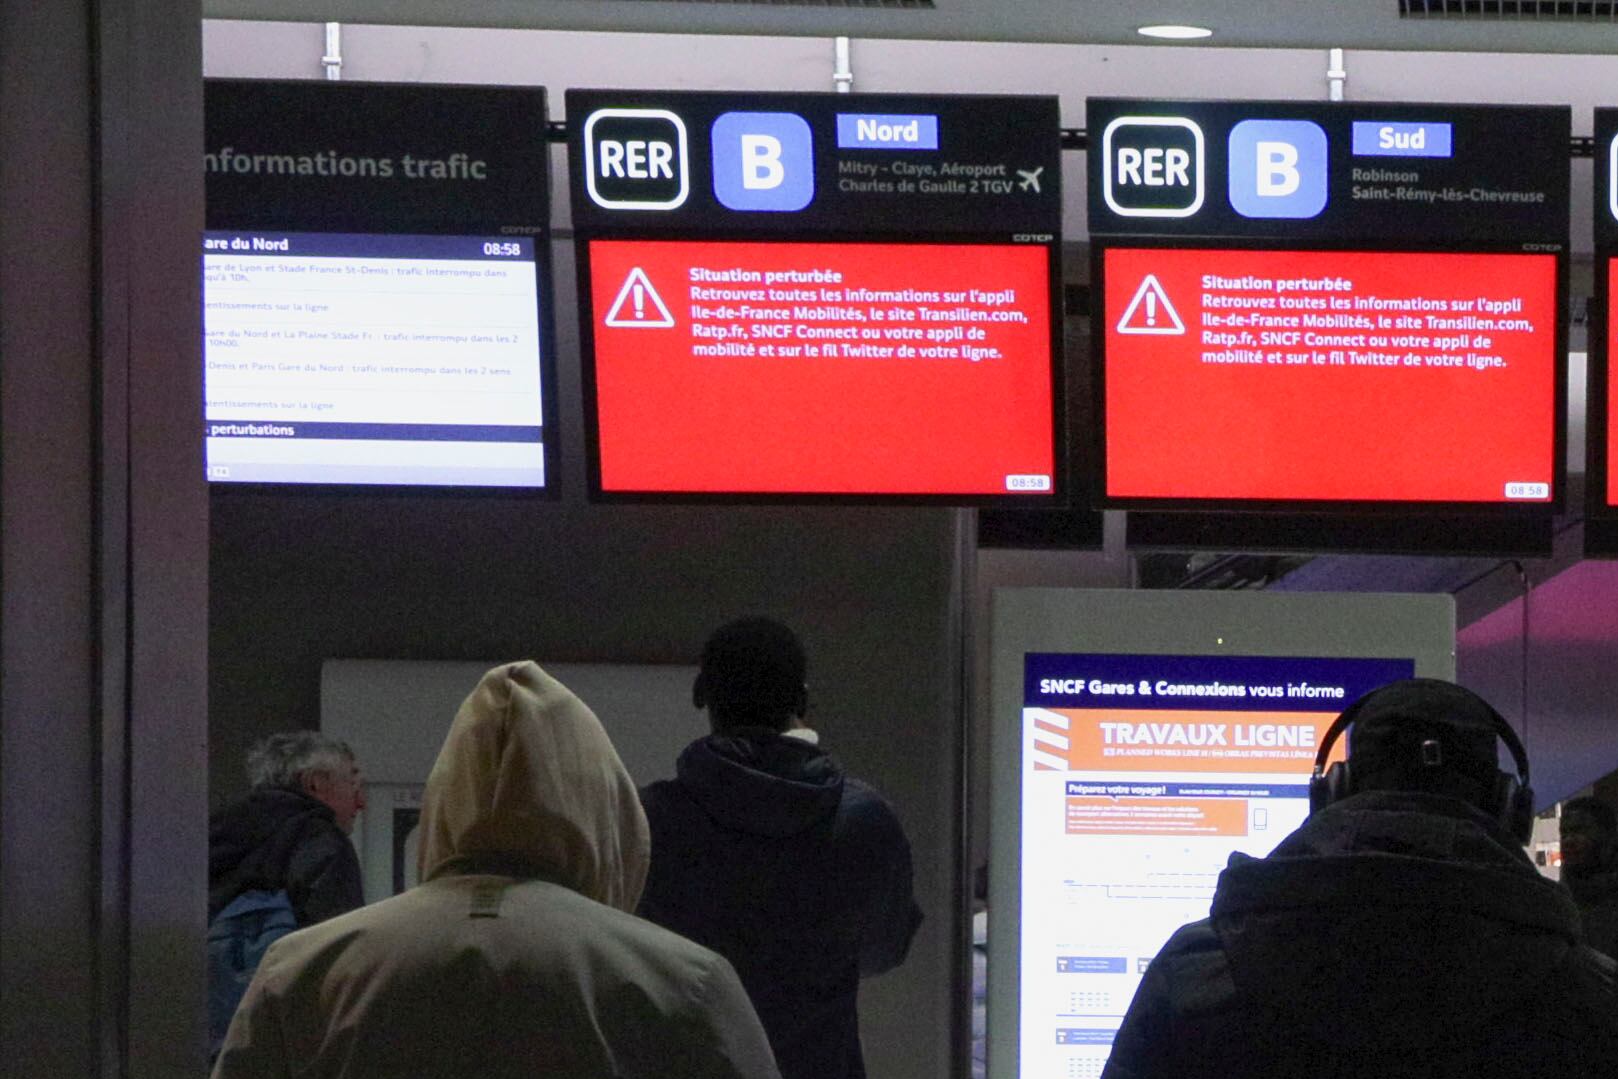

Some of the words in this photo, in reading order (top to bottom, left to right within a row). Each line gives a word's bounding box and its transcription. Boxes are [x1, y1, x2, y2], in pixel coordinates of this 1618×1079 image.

[857, 119, 919, 142] Nord
[1379, 126, 1425, 150] Sud
[204, 146, 393, 176] nformations
[402, 153, 487, 180] trafic
[599, 140, 674, 179] RER
[741, 134, 785, 190] B
[838, 161, 877, 176] Mitry
[892, 161, 937, 176] Claye,
[940, 162, 1006, 177] Aéroport
[1117, 147, 1190, 187] RER
[1256, 141, 1300, 197] B
[1352, 168, 1419, 182] Robinson
[839, 179, 893, 192] Charles
[898, 180, 915, 192] de
[919, 180, 966, 193] Gaulle
[970, 180, 979, 193] 2
[983, 180, 1014, 194] TGV
[1352, 186, 1545, 203] Saint-Rémy-lès-Chevreuse
[205, 239, 228, 250] are
[232, 237, 250, 250] du
[253, 237, 289, 251] Nord
[484, 242, 521, 256] 08:58
[689, 267, 762, 282] Situation
[764, 269, 843, 285] perturbée
[1201, 275, 1273, 290] Situation
[1276, 278, 1353, 293] perturbée
[690, 286, 766, 301] Retrouvez
[768, 289, 818, 301] toutes
[819, 288, 843, 301] les
[845, 288, 941, 302] informations
[943, 292, 967, 302] sur
[969, 290, 1015, 306] l'appli
[691, 305, 791, 320] Ile-de-France
[793, 306, 868, 322] Mobilités,
[869, 307, 885, 320] le
[887, 307, 916, 321] site
[917, 307, 1028, 323] Transilien.com,
[691, 323, 749, 340] Ratp.fr,
[751, 324, 793, 338] SNCF
[795, 325, 859, 339] Connect
[861, 329, 881, 339] ou
[883, 327, 924, 339] votre
[926, 326, 964, 342] appli
[966, 327, 986, 340] de
[211, 424, 295, 437] perturbations
[1011, 478, 1044, 488] 08:58
[1039, 678, 1085, 694] SNCF
[1088, 679, 1136, 696] Gares
[1137, 680, 1153, 696] &
[1154, 680, 1247, 697] Connexions
[1248, 685, 1285, 698] vous
[1287, 681, 1345, 699] informe
[1099, 722, 1228, 746] TRAVAUX
[1234, 724, 1316, 748] LIGNE
[1068, 784, 1106, 795] Préparez
[1107, 785, 1130, 794] votre
